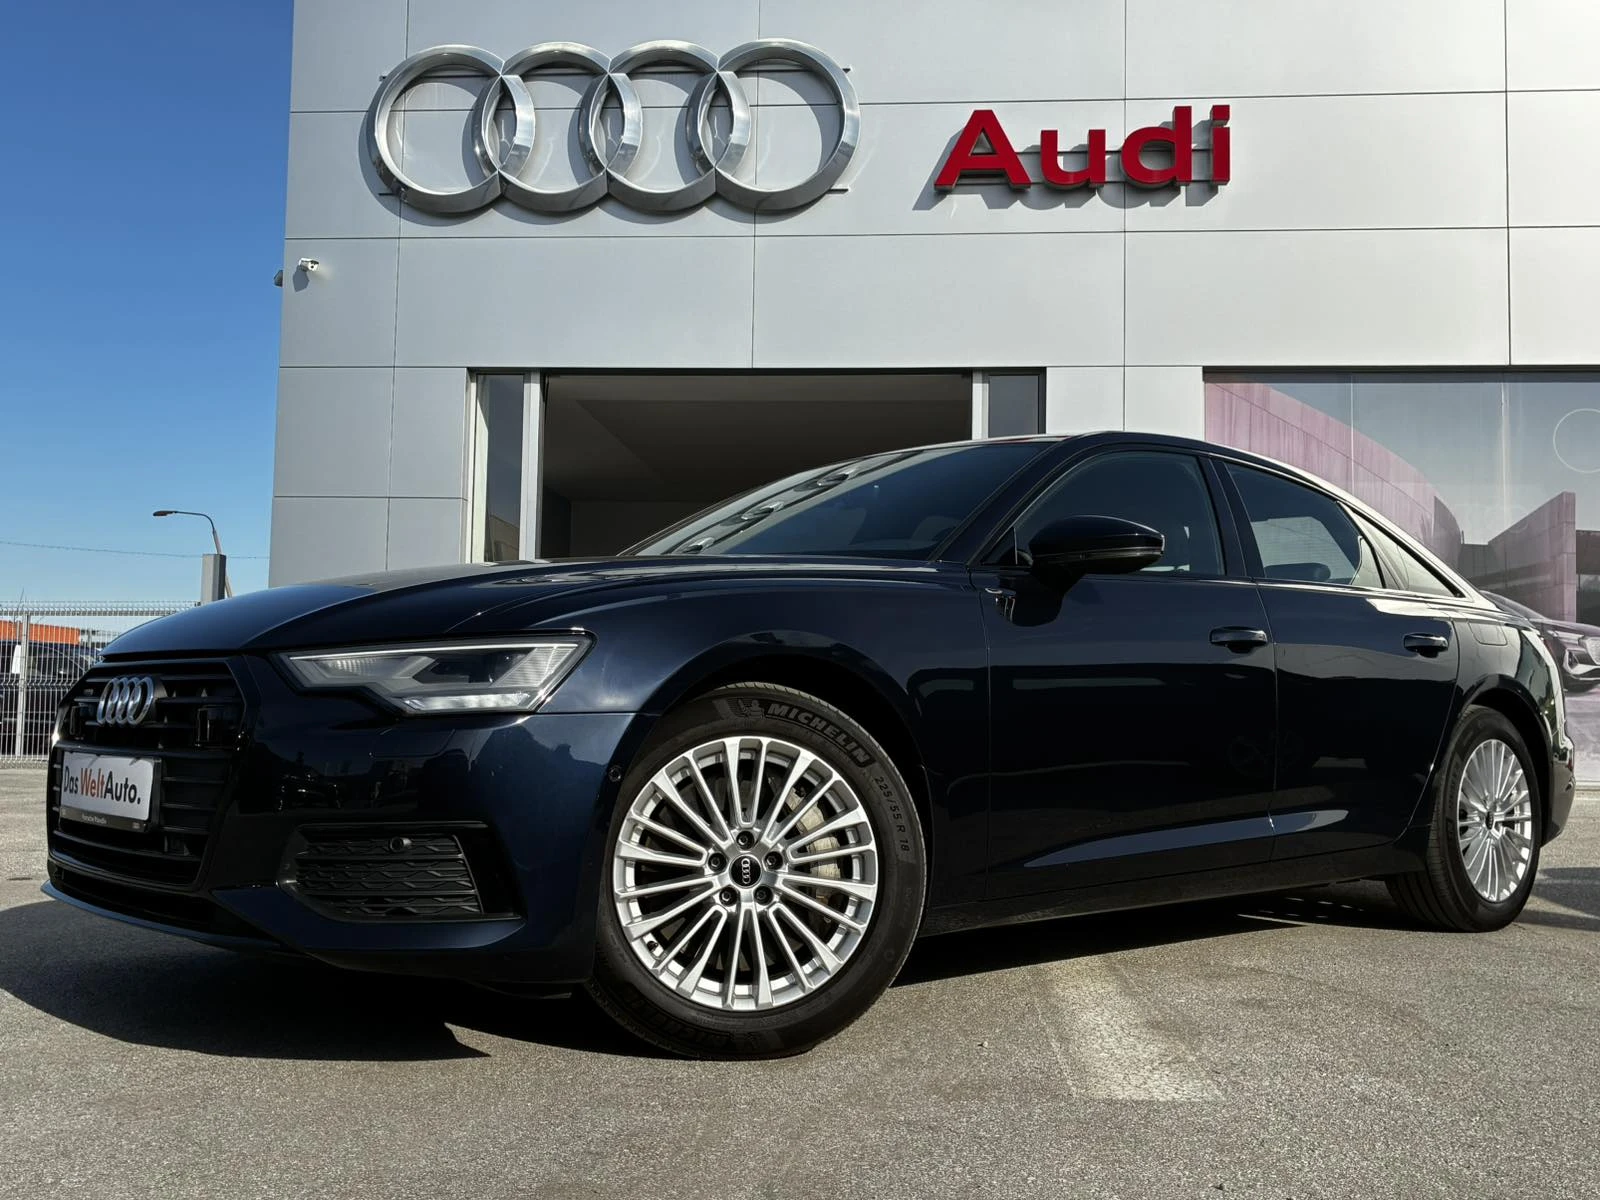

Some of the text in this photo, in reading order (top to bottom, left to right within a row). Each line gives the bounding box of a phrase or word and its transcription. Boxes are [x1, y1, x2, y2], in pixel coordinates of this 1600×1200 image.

[934, 104, 1231, 190] Audi
[766, 702, 872, 765] MICHELIN
[63, 766, 142, 805] Das WeltAuto.
[874, 776, 910, 852] 225/55 R 18
